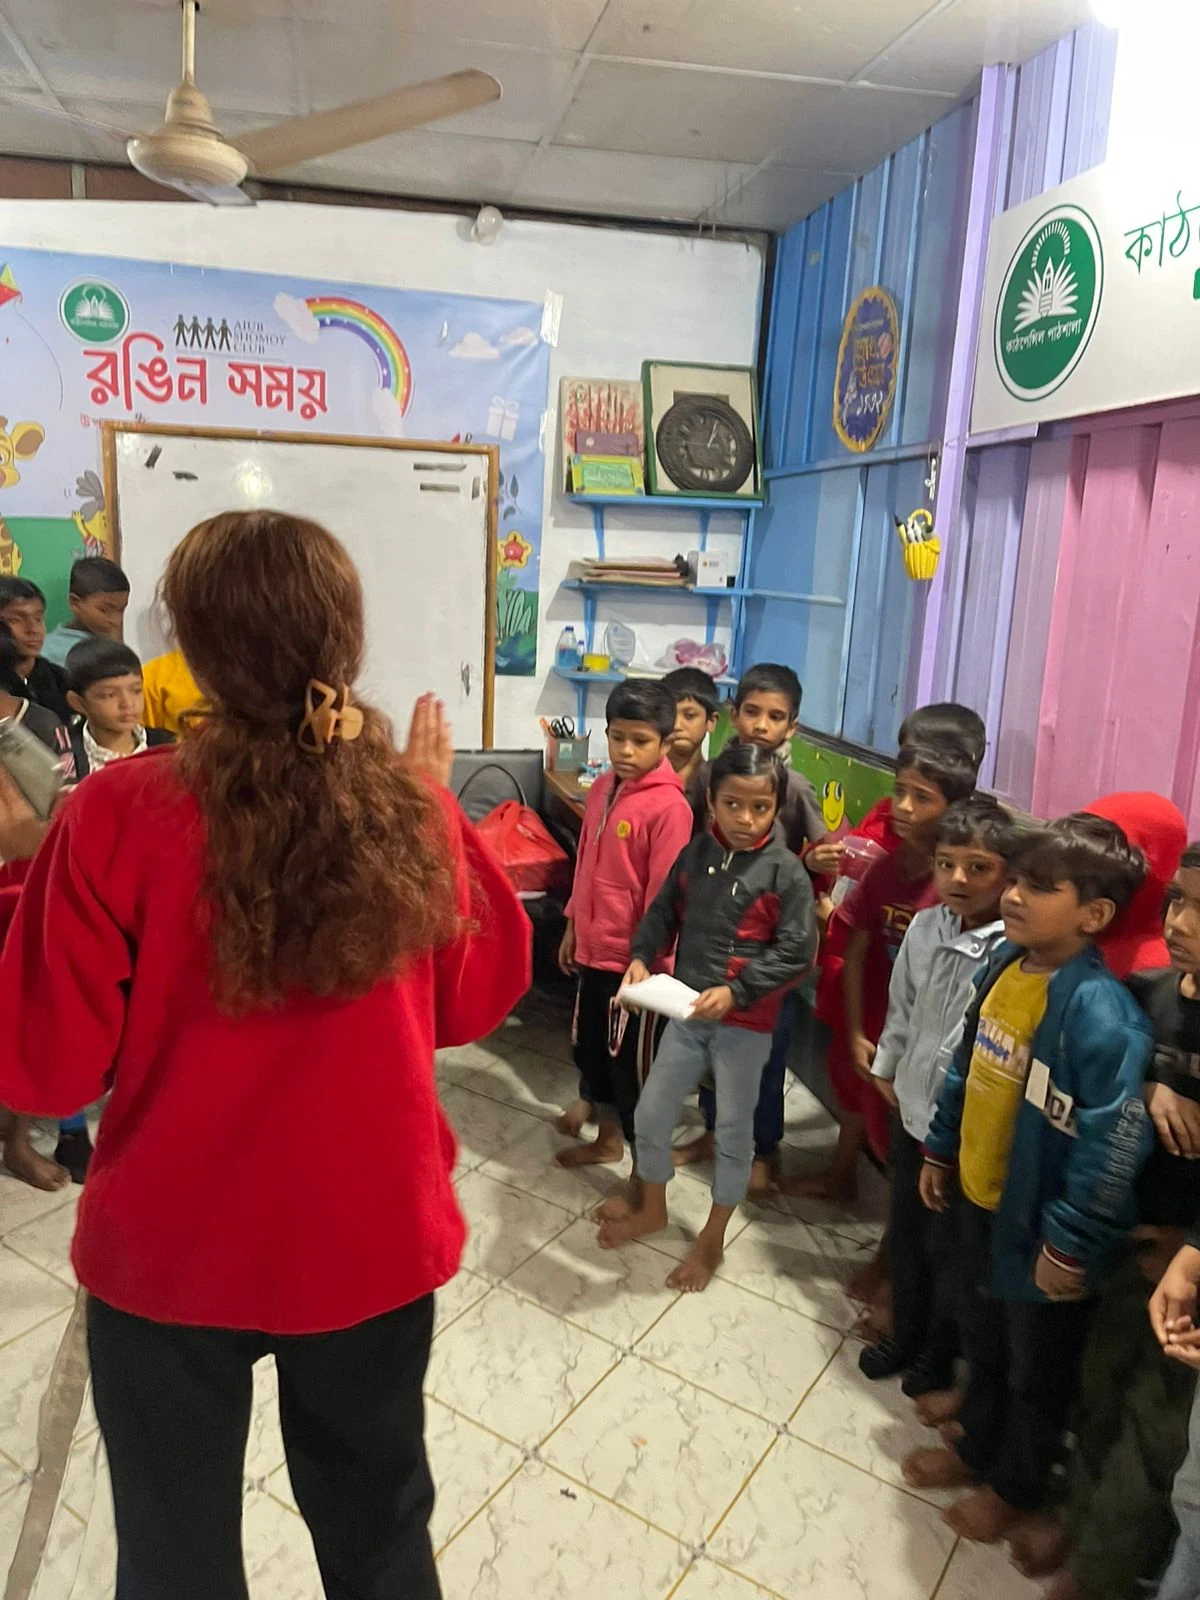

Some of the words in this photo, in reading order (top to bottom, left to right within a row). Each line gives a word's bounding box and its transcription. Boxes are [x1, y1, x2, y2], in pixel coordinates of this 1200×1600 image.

[1124, 190, 1200, 275] কাঠ
[233, 343, 265, 355] CLUB
[234, 329, 286, 346] SHOMOY
[82, 331, 207, 411] রঙিন
[228, 361, 328, 420] সময়
